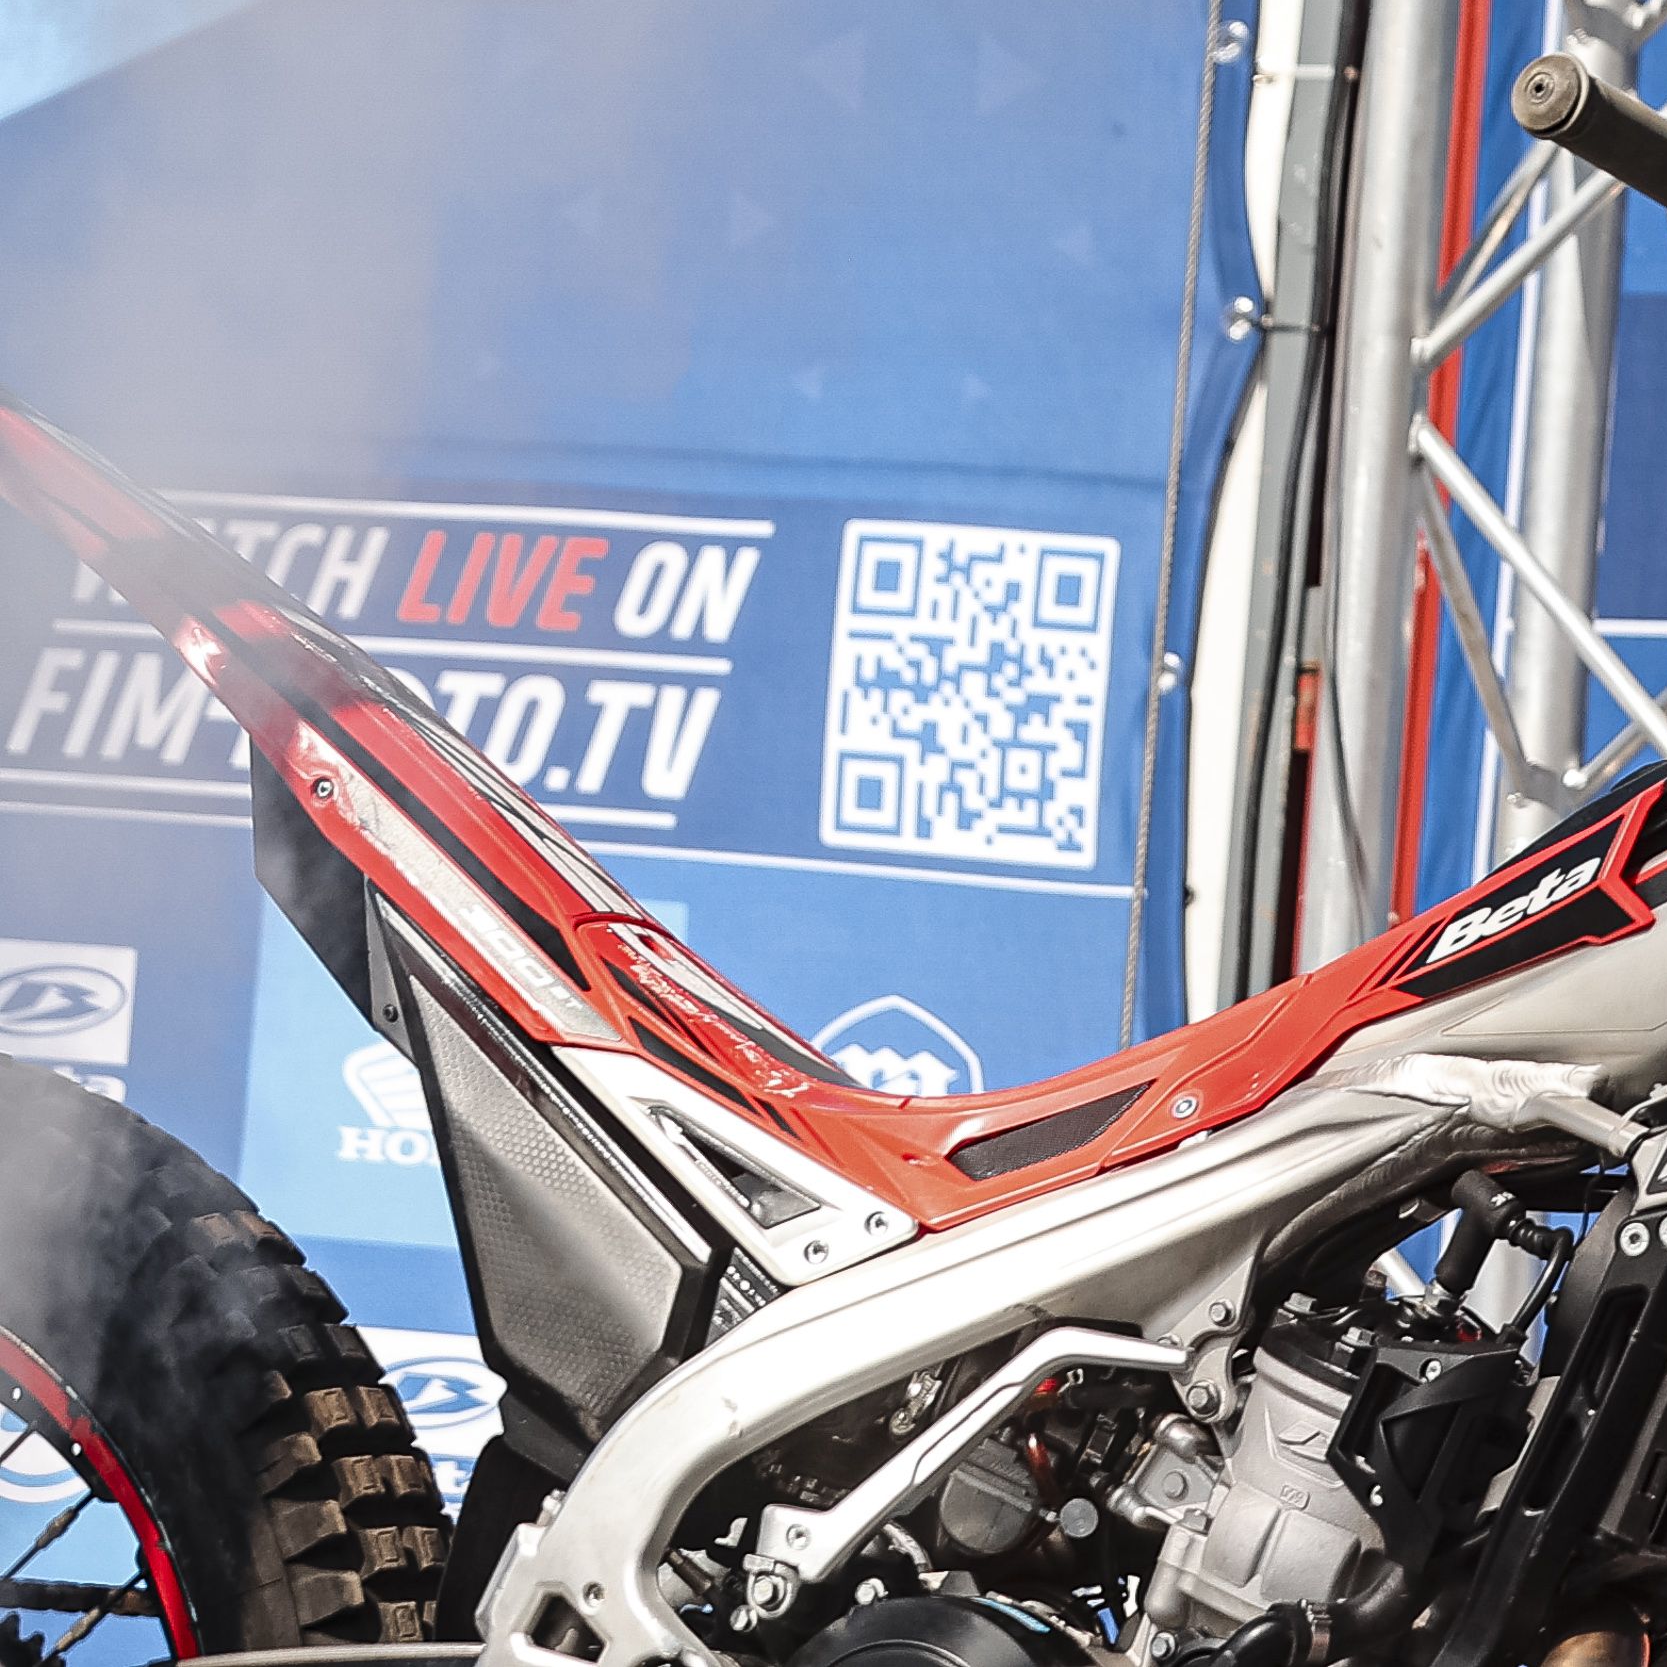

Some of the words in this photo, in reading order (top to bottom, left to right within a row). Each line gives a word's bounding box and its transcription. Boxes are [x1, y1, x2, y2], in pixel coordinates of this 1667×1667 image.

[396, 530, 610, 631] LIVE
[613, 540, 761, 643] ON
[1426, 854, 1600, 963] Beta
